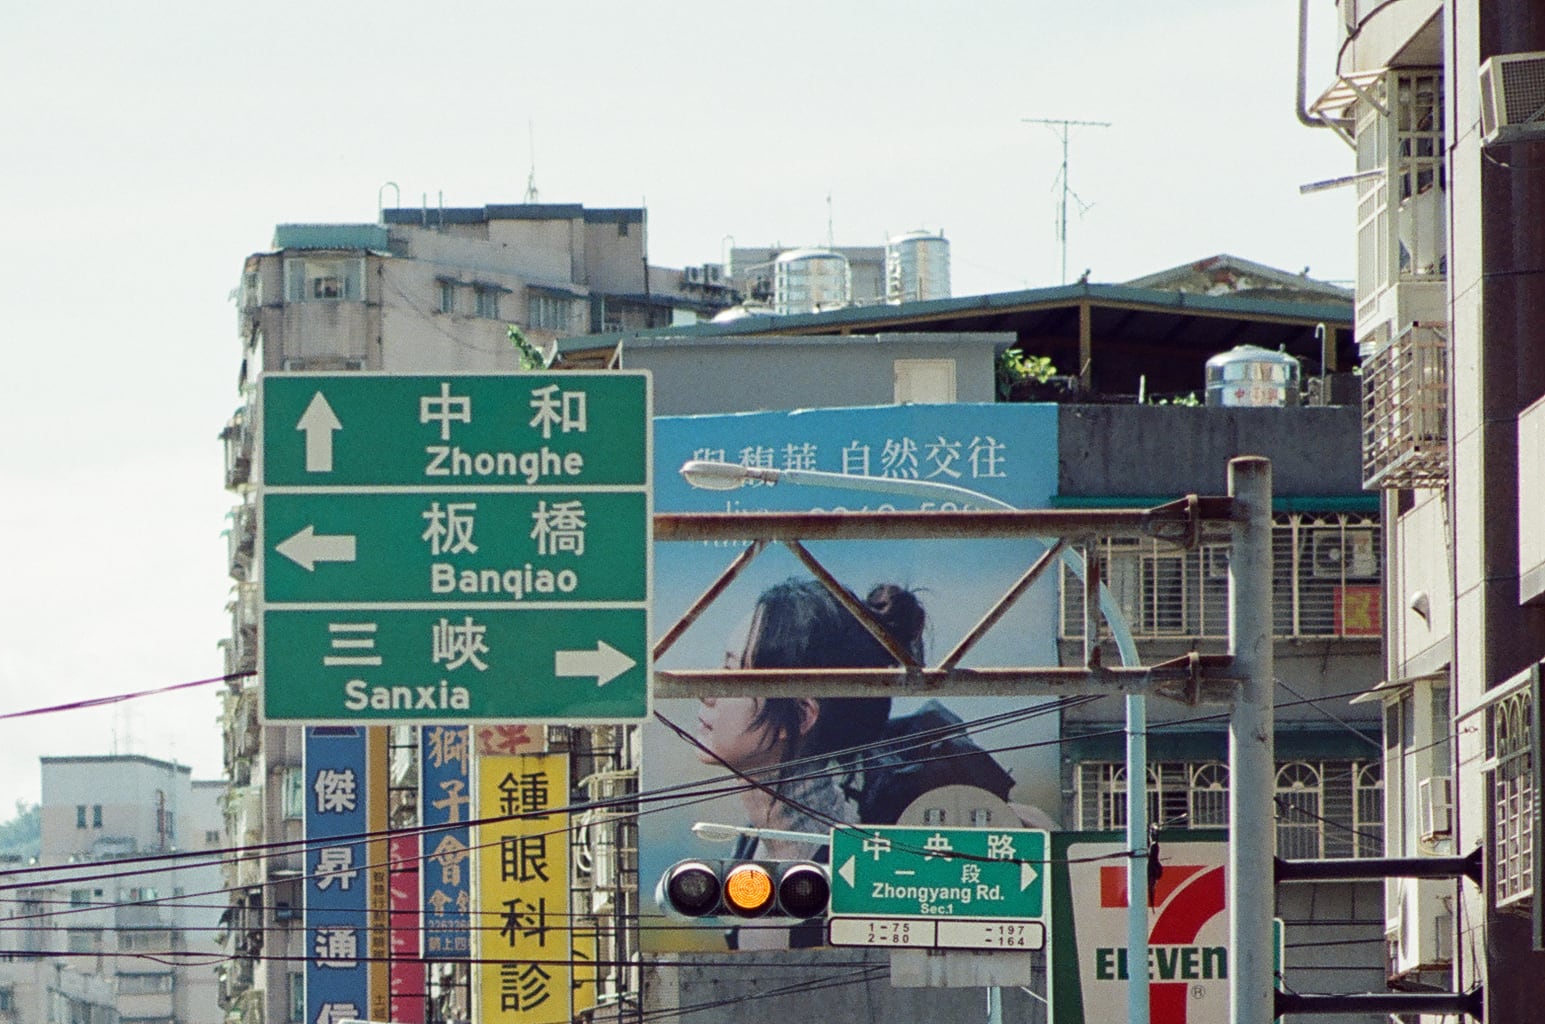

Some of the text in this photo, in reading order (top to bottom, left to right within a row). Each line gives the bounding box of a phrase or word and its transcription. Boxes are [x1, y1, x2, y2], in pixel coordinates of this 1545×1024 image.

[419, 383, 588, 441] 中和
[425, 446, 584, 484] Zhonghe
[841, 436, 1007, 479] 自然交往
[421, 501, 586, 556] 板橋
[431, 563, 578, 600] Banqiao
[323, 617, 489, 672] 三峽
[345, 680, 470, 711] Sanxia
[863, 832, 1016, 863] 中央路
[895, 864, 981, 883] 一段
[872, 883, 1005, 902] Zhongyang Rd.
[920, 903, 953, 915] Sec.1
[1096, 946, 1228, 980] ELVEn
